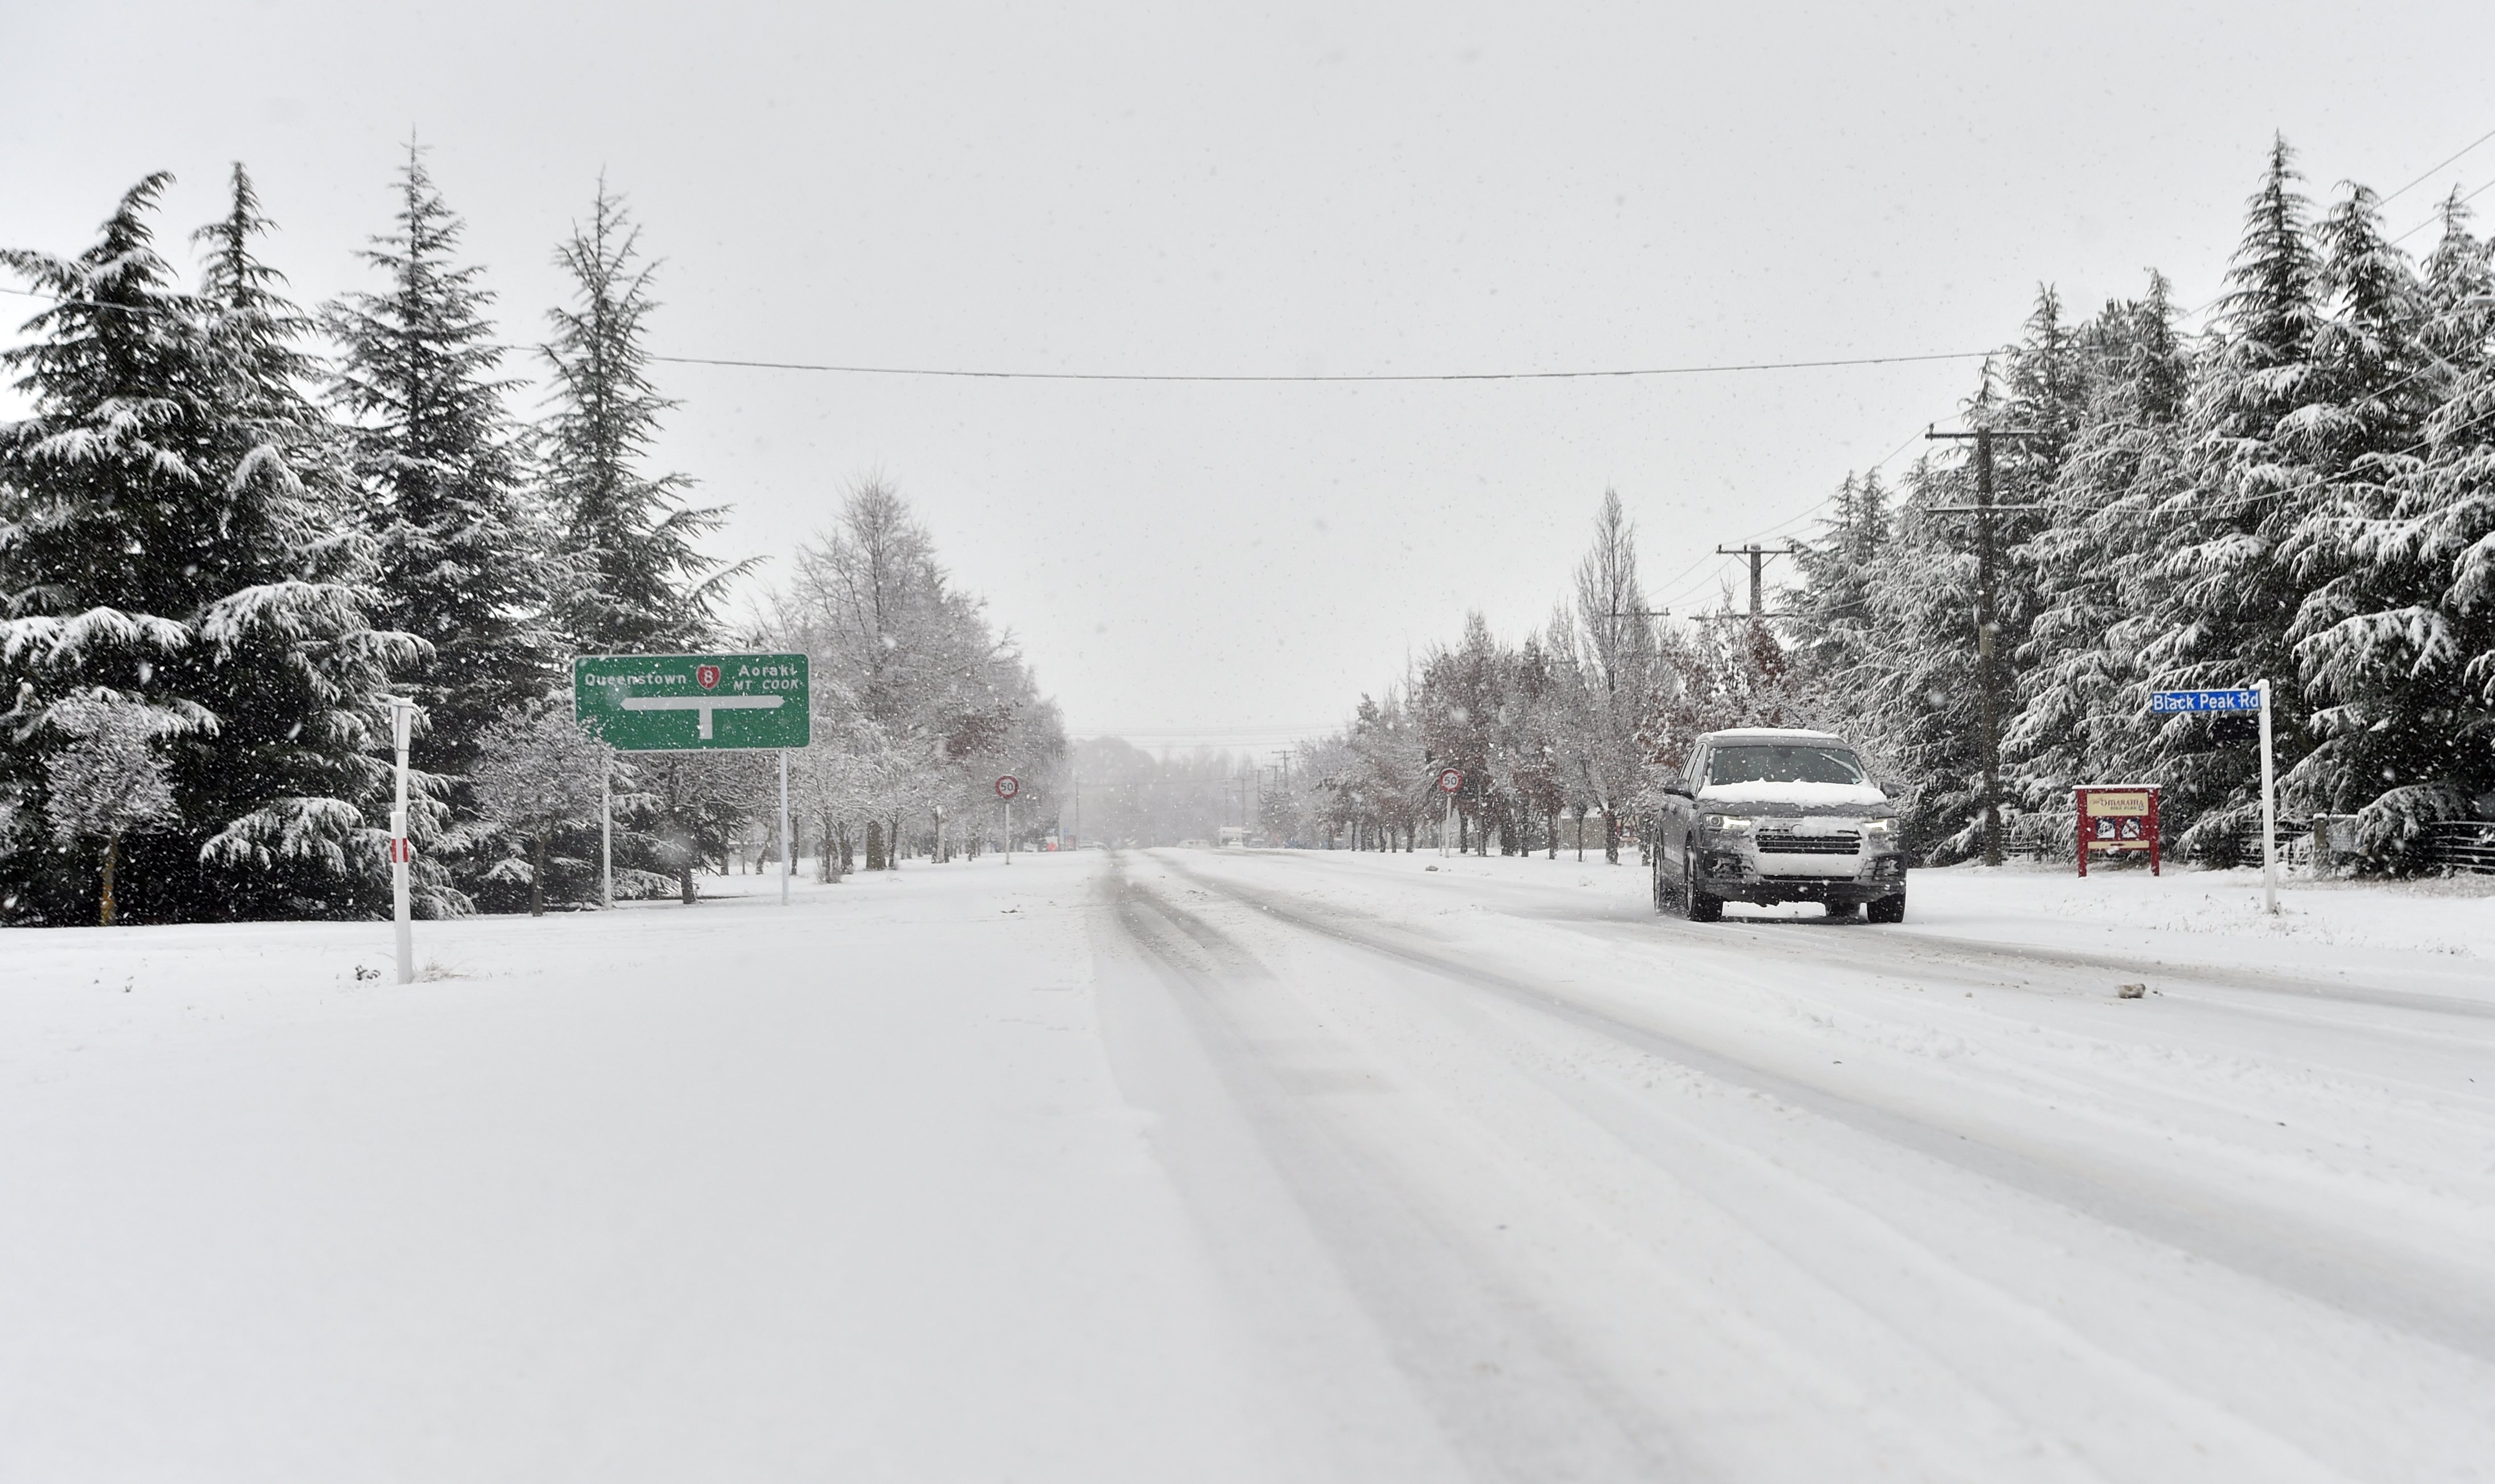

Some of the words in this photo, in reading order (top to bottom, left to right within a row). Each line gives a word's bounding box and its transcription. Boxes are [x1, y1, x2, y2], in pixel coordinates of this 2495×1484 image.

[739, 663, 795, 677] Aoraki
[585, 673, 687, 686] Queenstown
[704, 670, 713, 684] 8
[733, 680, 753, 691] MT
[762, 679, 798, 690] COOK
[2153, 693, 2194, 711] Black
[2200, 692, 2235, 710] Peak
[2240, 691, 2258, 708] Rd
[1001, 782, 1014, 792] 50
[1444, 776, 1457, 785] 50
